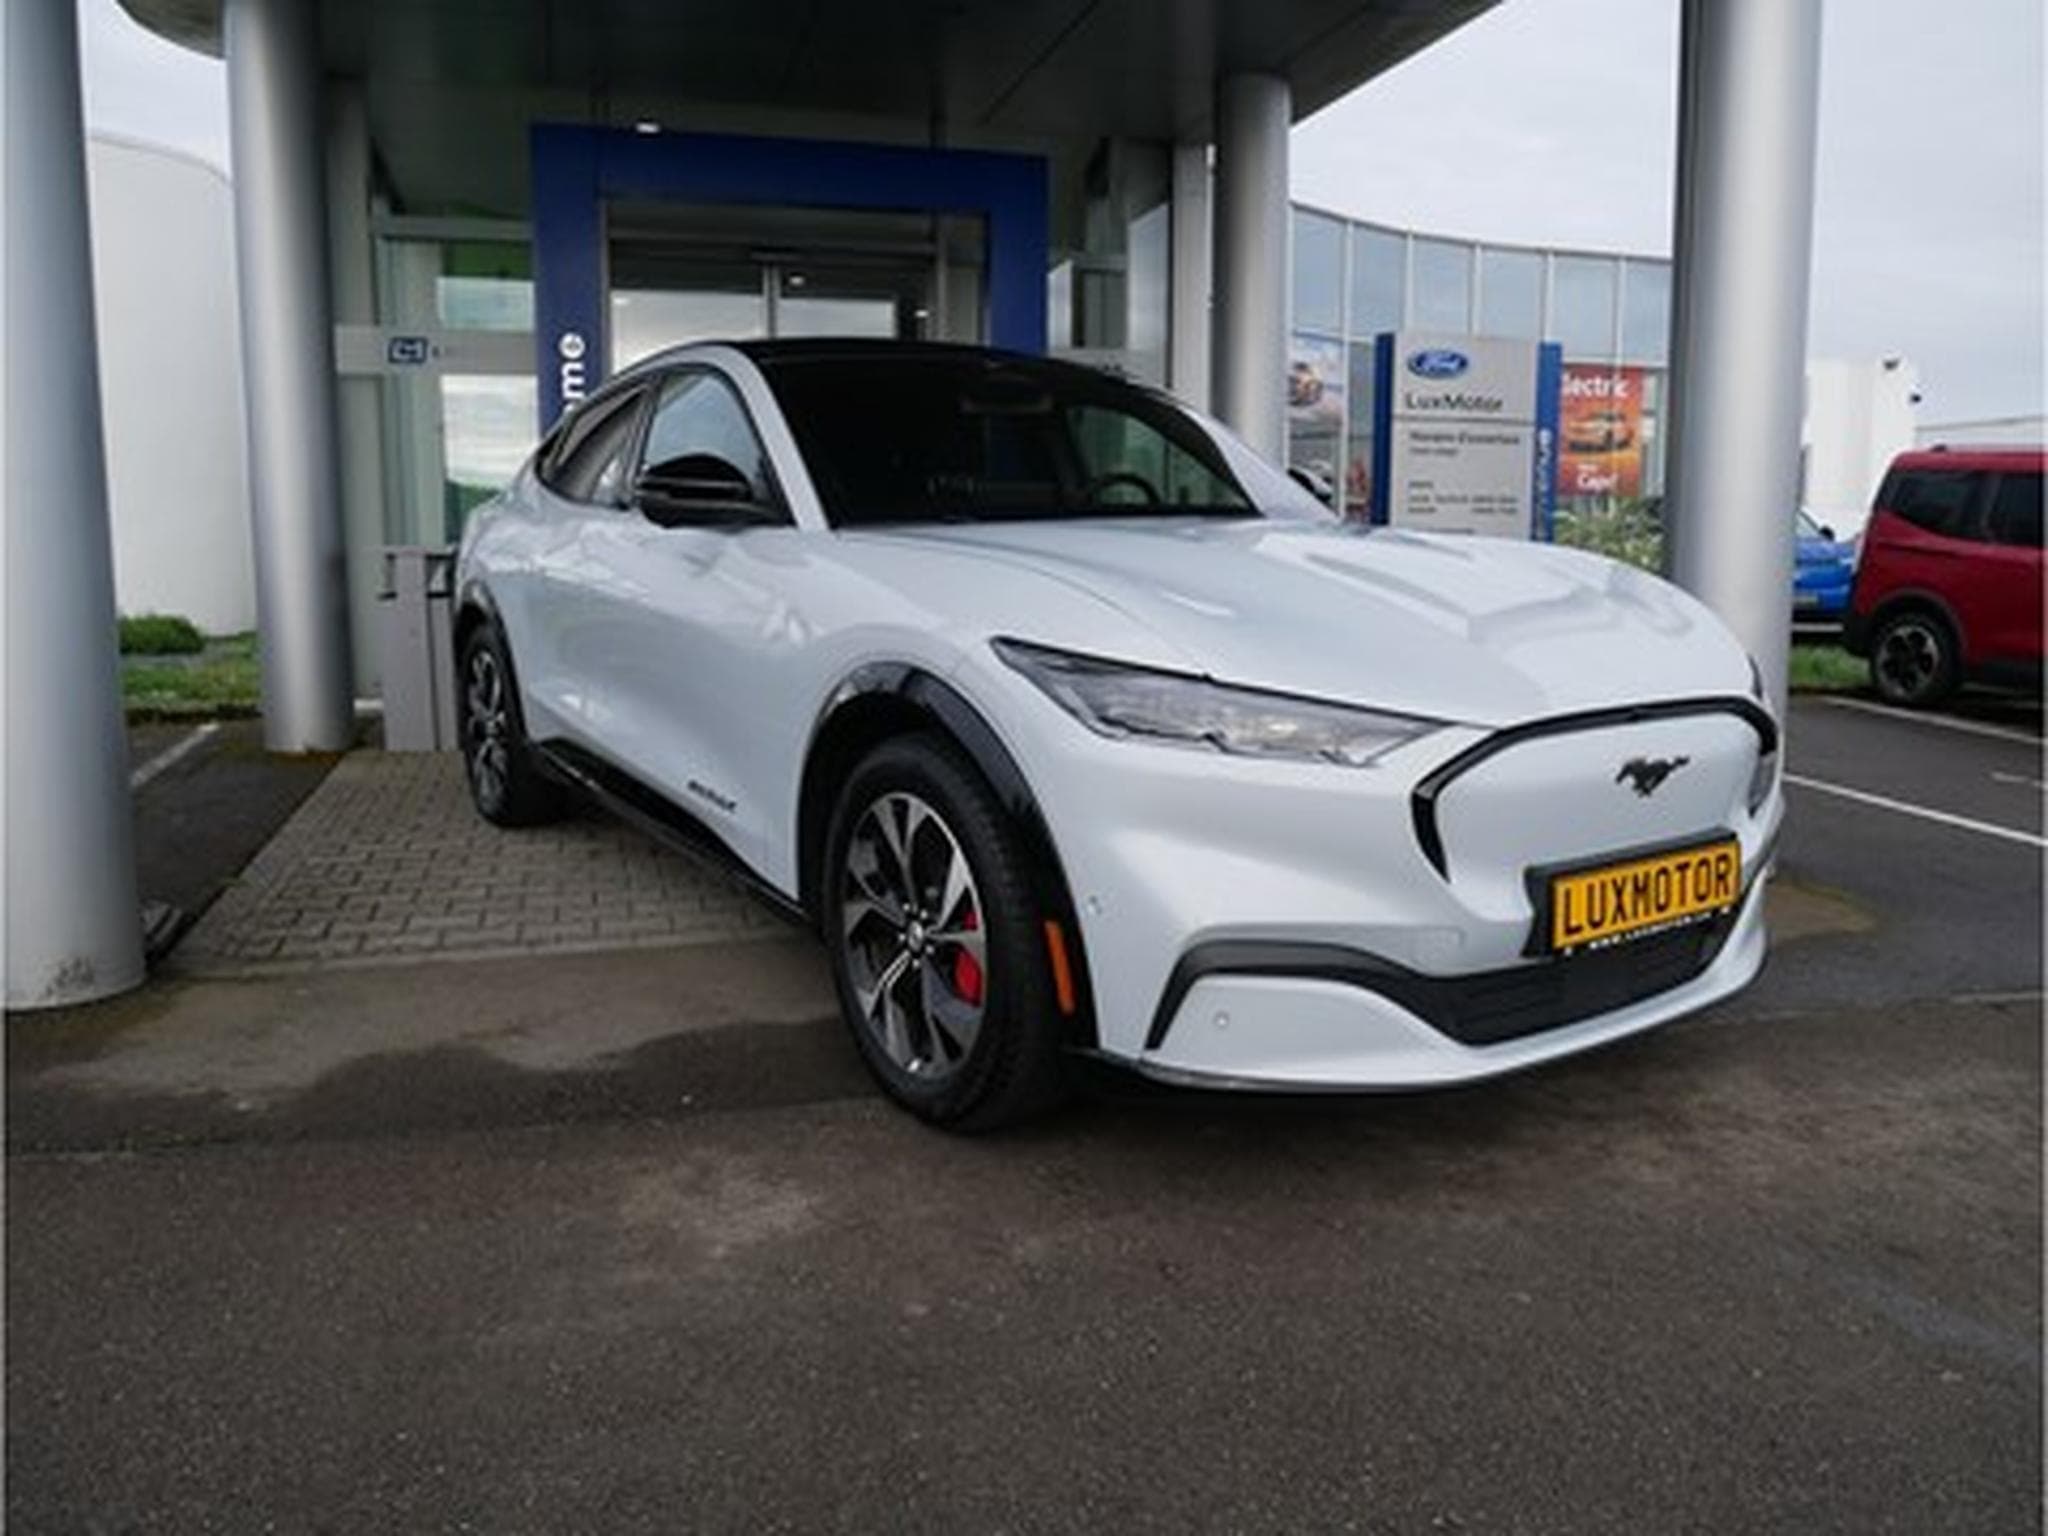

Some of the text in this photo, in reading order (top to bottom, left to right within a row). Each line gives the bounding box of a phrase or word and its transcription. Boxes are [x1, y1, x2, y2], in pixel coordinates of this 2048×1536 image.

[559, 332, 586, 412] me
[1562, 373, 1627, 397] lectric
[1405, 393, 1503, 412] LuxMotor
[1563, 853, 1732, 935] LUXMOTOR
